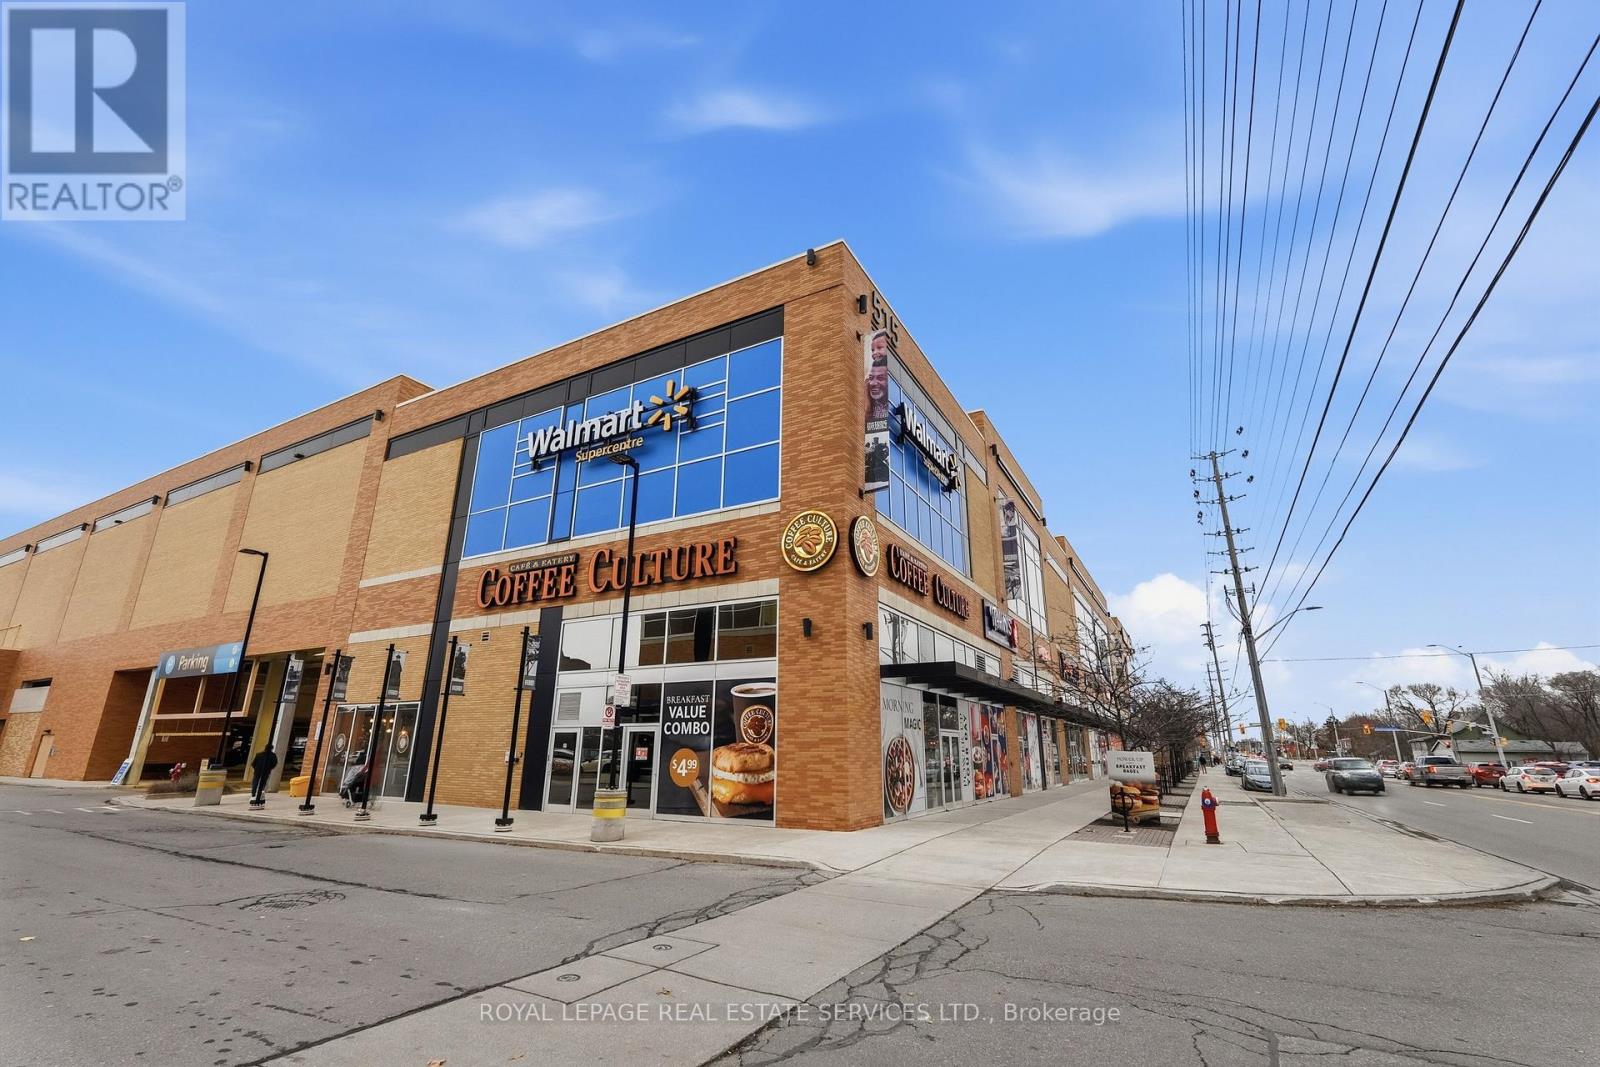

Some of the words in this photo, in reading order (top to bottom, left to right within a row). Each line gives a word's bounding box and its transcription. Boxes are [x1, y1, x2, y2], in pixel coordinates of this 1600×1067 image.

[871, 290, 899, 349] 515
[528, 400, 644, 458] Walmart
[904, 403, 951, 474] Walmart
[575, 436, 644, 463] Supercentre
[785, 516, 806, 549] COFFEE
[806, 514, 833, 543] CULTURE
[477, 564, 578, 609] COFFEE
[588, 537, 737, 594] CULTURE
[541, 555, 576, 567] EATERY
[890, 543, 929, 596] COFFEE
[935, 574, 970, 619] CULTURE
[177, 652, 210, 673] Parking
[666, 694, 711, 704] BREAKFAST
[882, 697, 914, 713] MORNING
[668, 705, 707, 719] VALUE
[903, 717, 921, 730] MAGIC
[663, 721, 710, 735] COMBO
